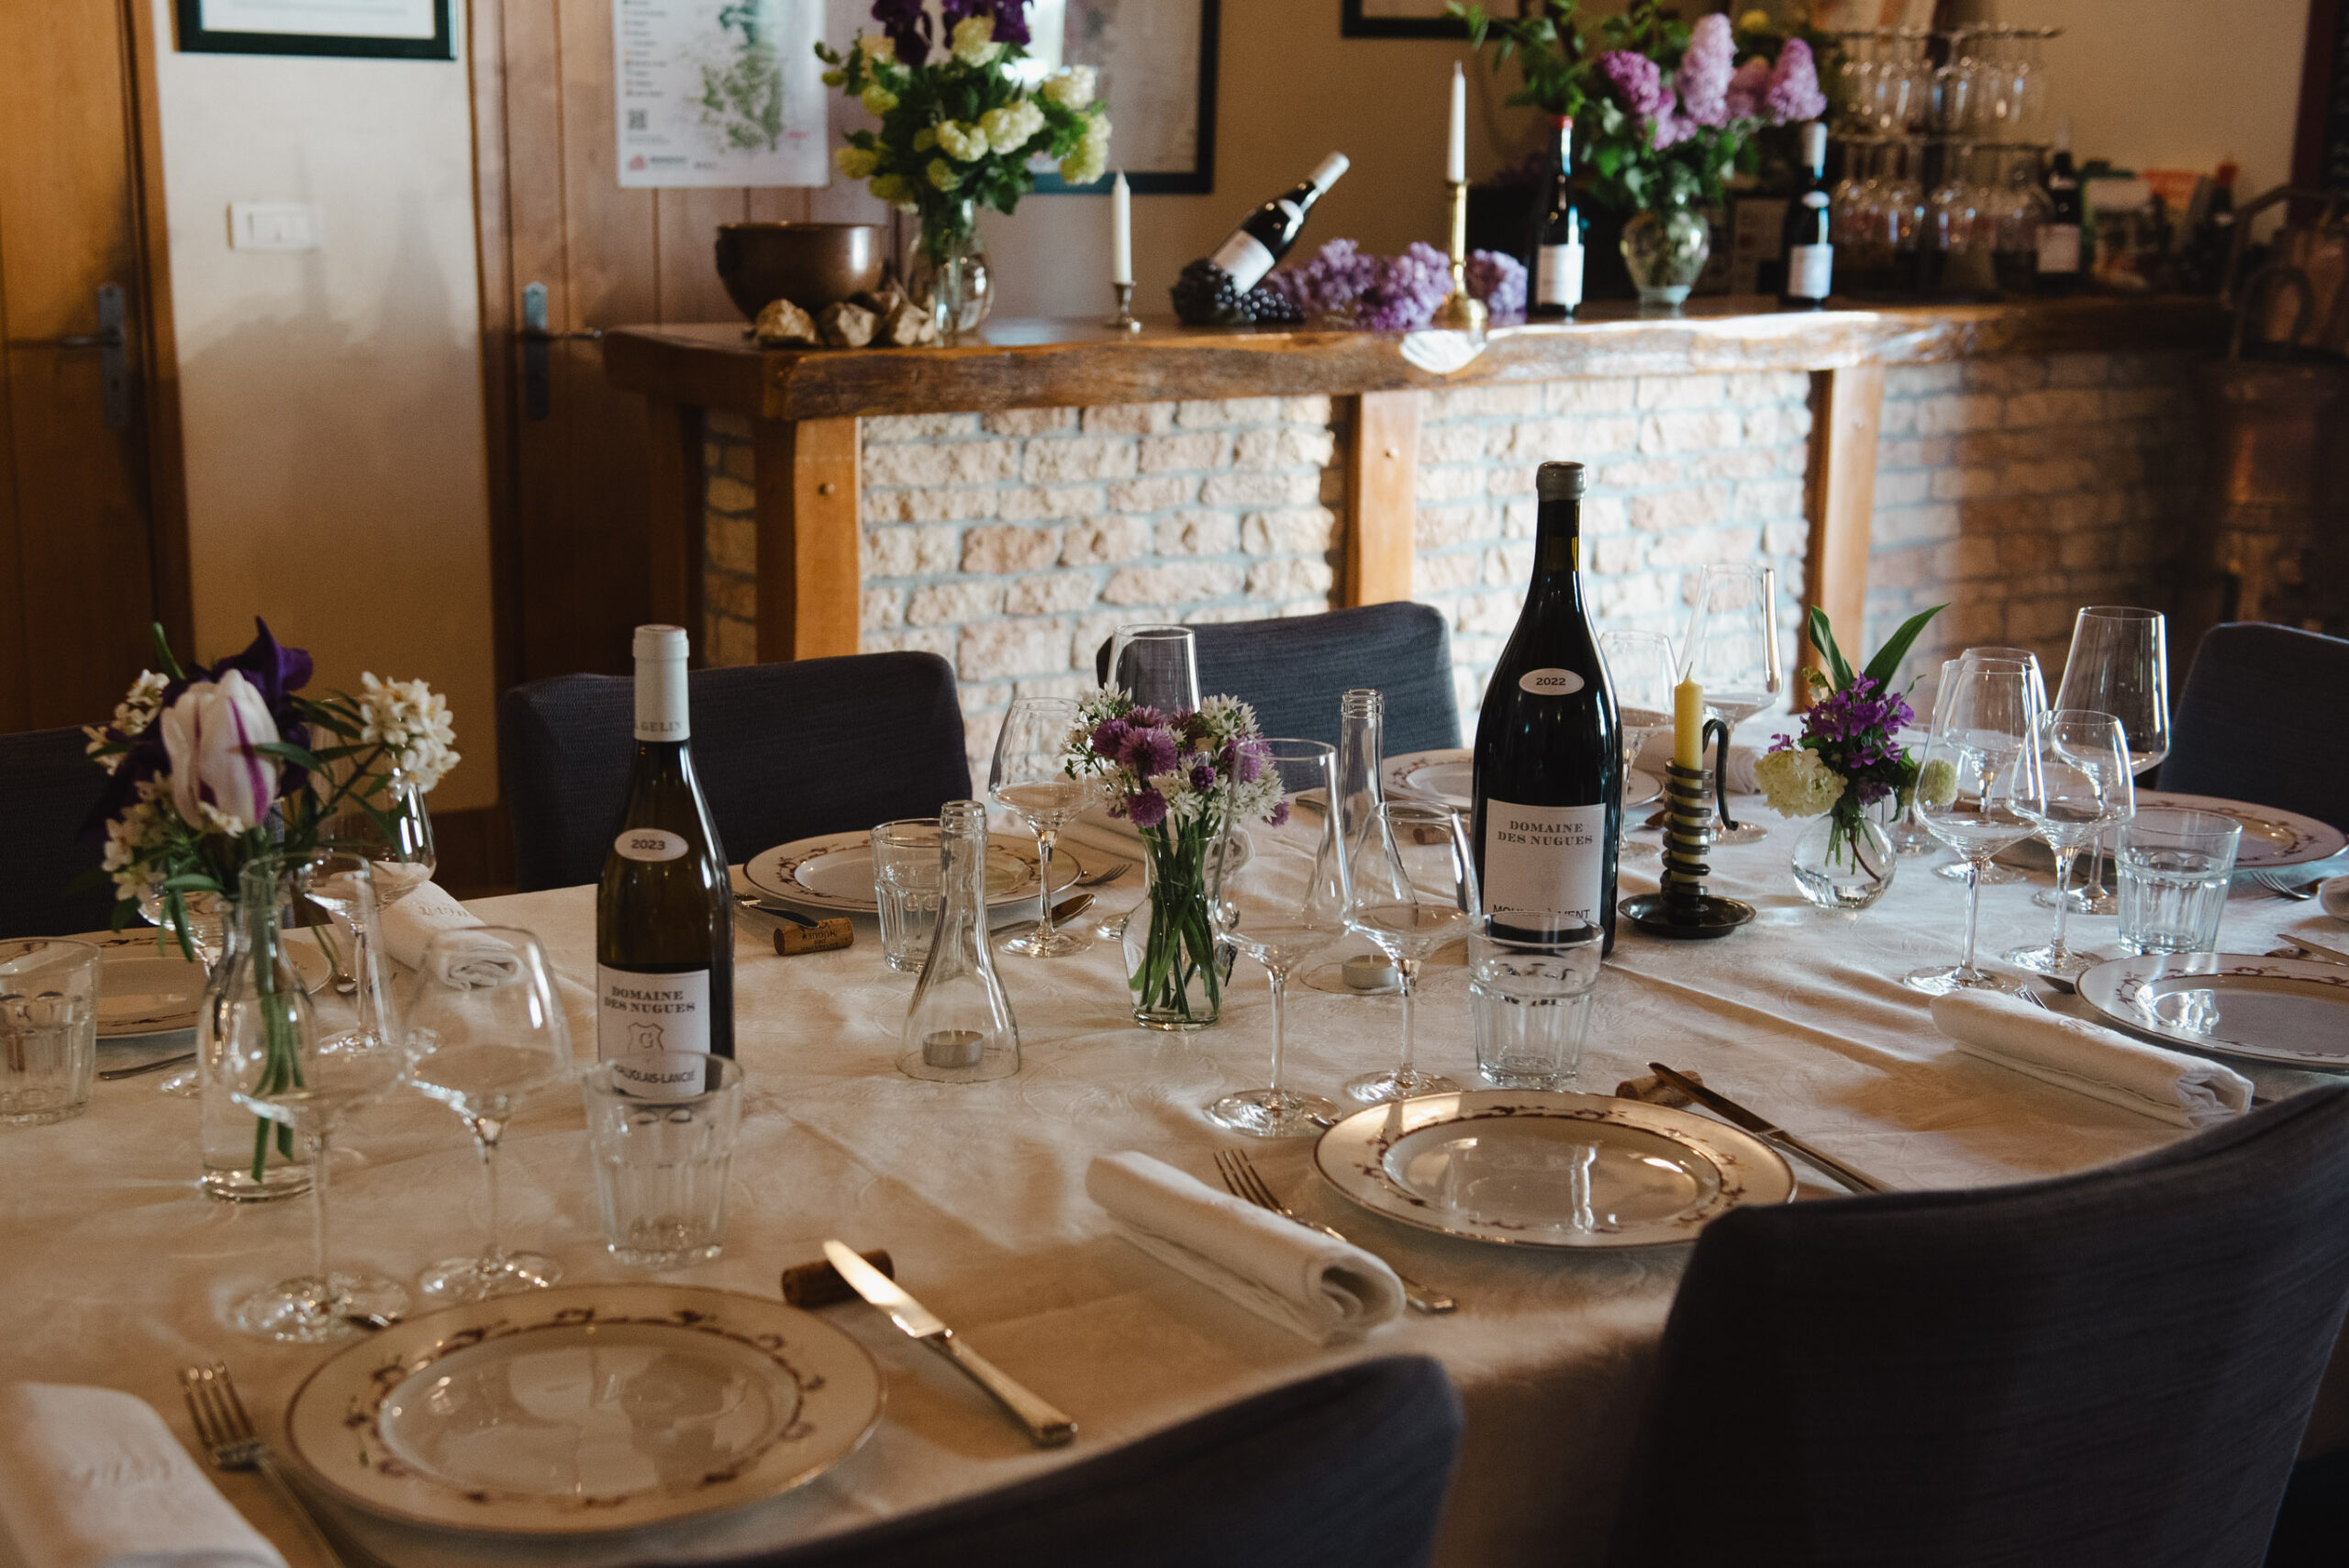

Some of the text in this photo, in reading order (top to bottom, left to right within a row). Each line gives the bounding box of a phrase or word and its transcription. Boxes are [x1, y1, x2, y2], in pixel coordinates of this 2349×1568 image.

[1536, 677, 1566, 686] 2022
[1509, 819, 1584, 834] DOMAINE
[631, 839, 666, 851] 2023
[1497, 830, 1593, 846] DES NUGUES
[611, 985, 685, 1001] DOMAINE
[604, 996, 696, 1014] DES NUGUES
